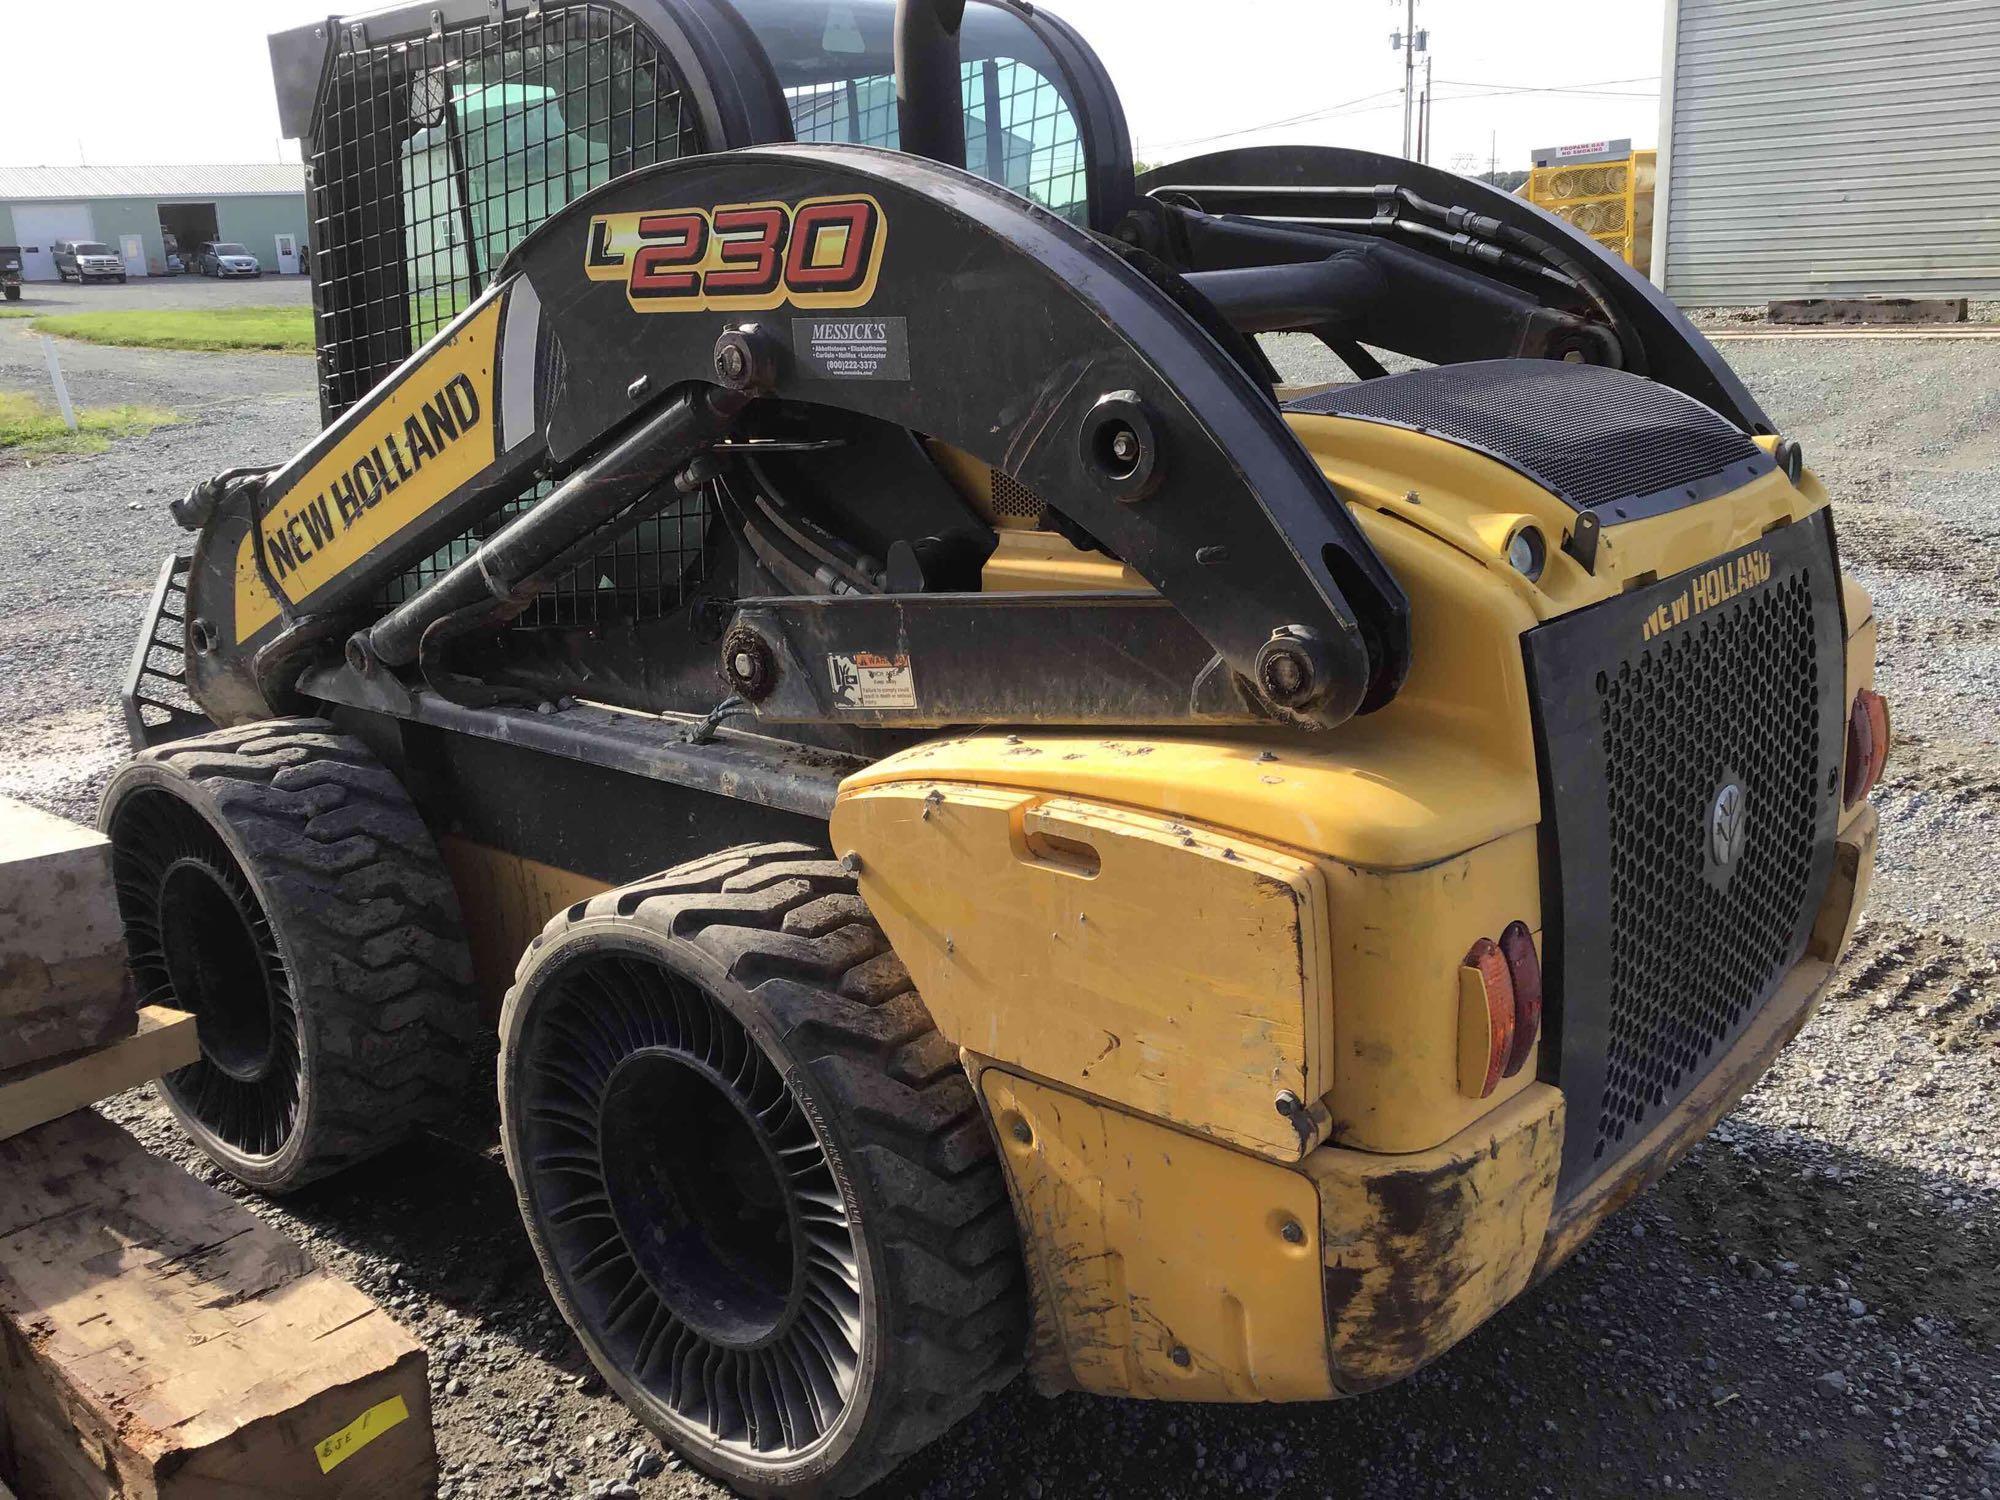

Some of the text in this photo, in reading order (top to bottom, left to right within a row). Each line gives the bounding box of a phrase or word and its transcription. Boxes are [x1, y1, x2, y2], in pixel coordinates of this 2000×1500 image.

[1560, 143, 1589, 151] PROPANE
[587, 200, 880, 299] L230
[812, 323, 886, 340] MESSICK'S
[826, 360, 878, 370] (800)222-3373
[267, 373, 480, 580] NEW HOLLAND
[1643, 549, 1771, 641] NEW HOLLAND
